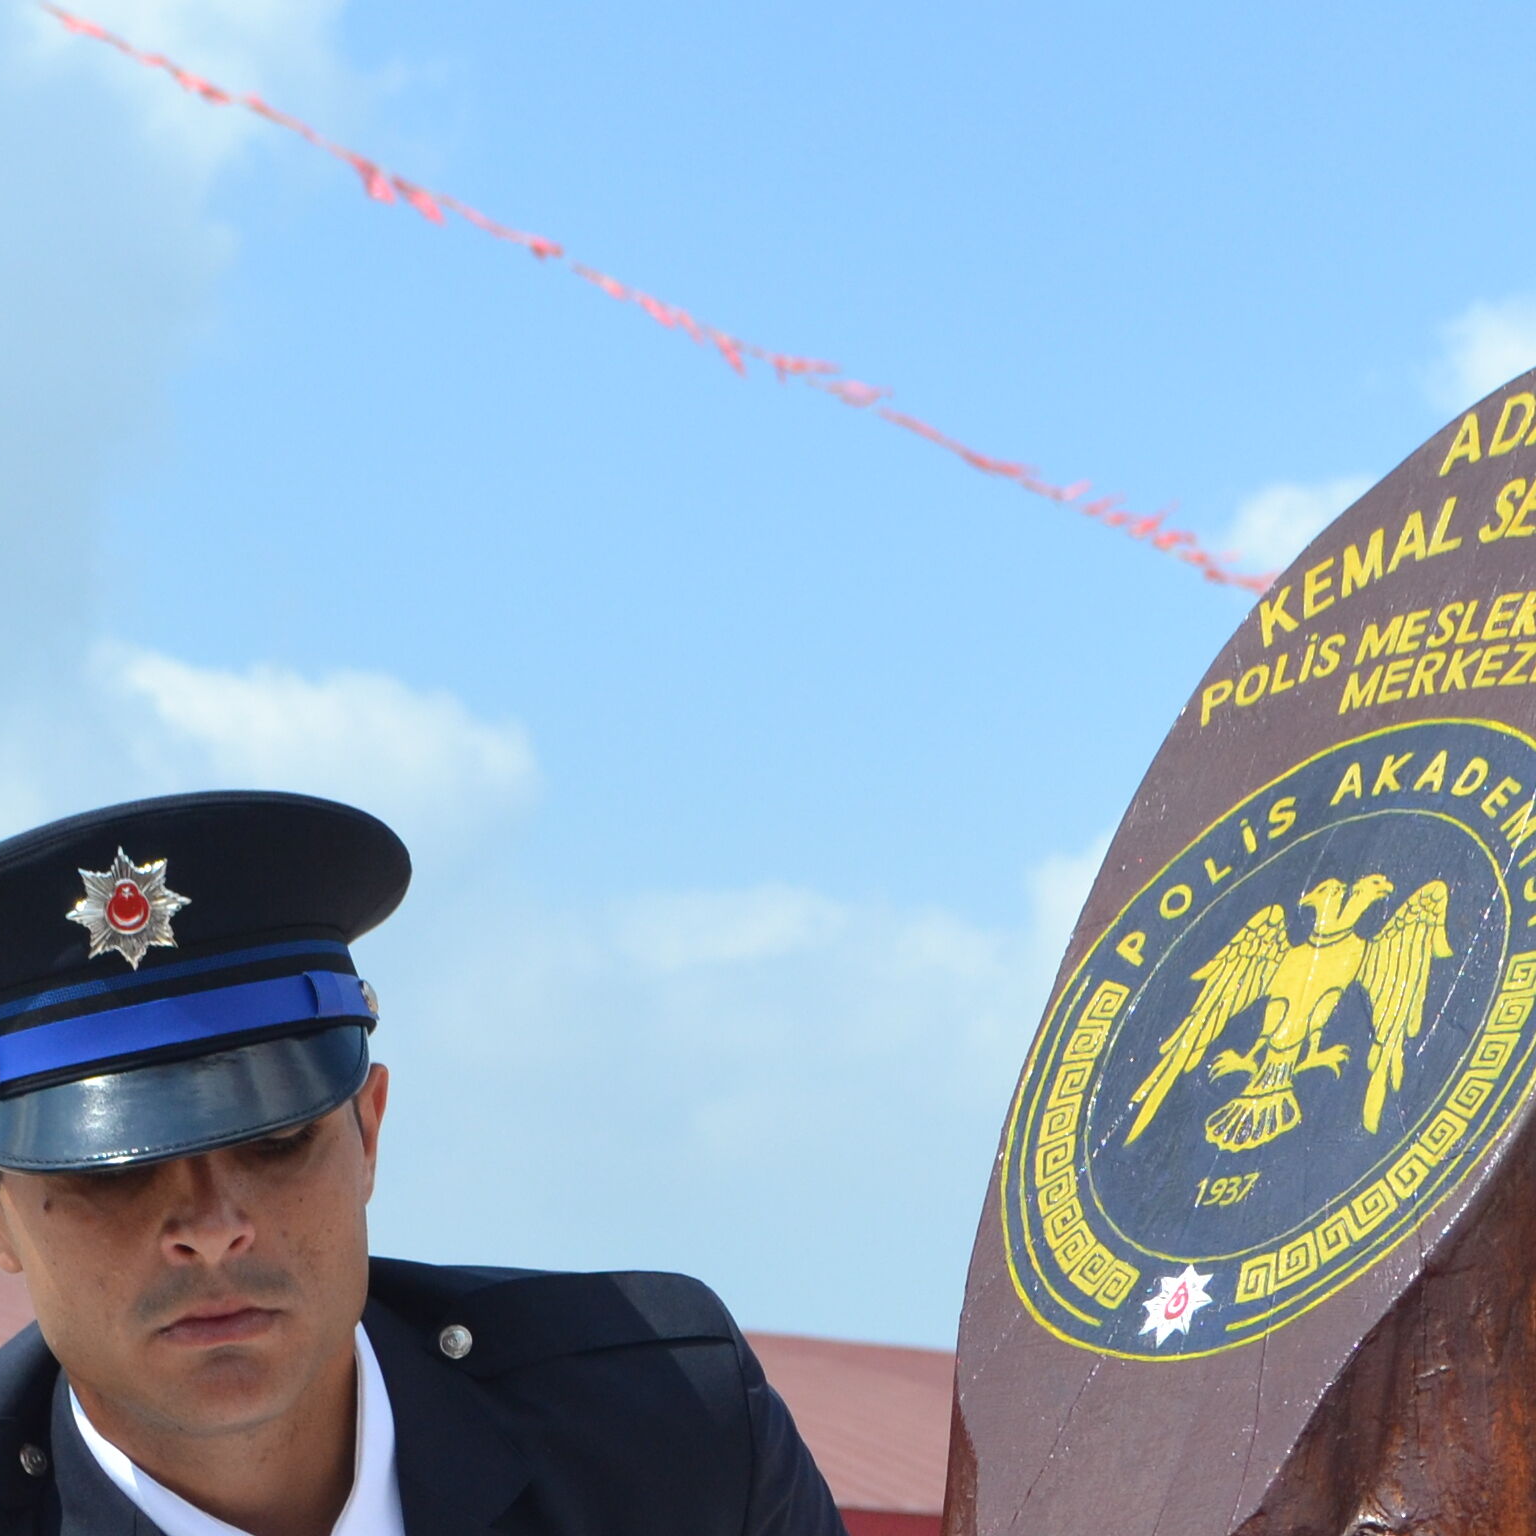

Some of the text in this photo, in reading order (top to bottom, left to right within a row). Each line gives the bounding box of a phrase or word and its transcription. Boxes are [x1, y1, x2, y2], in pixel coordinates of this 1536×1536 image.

[1259, 496, 1462, 647] KEMAL
[1200, 633, 1347, 727] POLİS
[1116, 796, 1296, 967] POLİS
[1194, 1172, 1261, 1208] 1937
